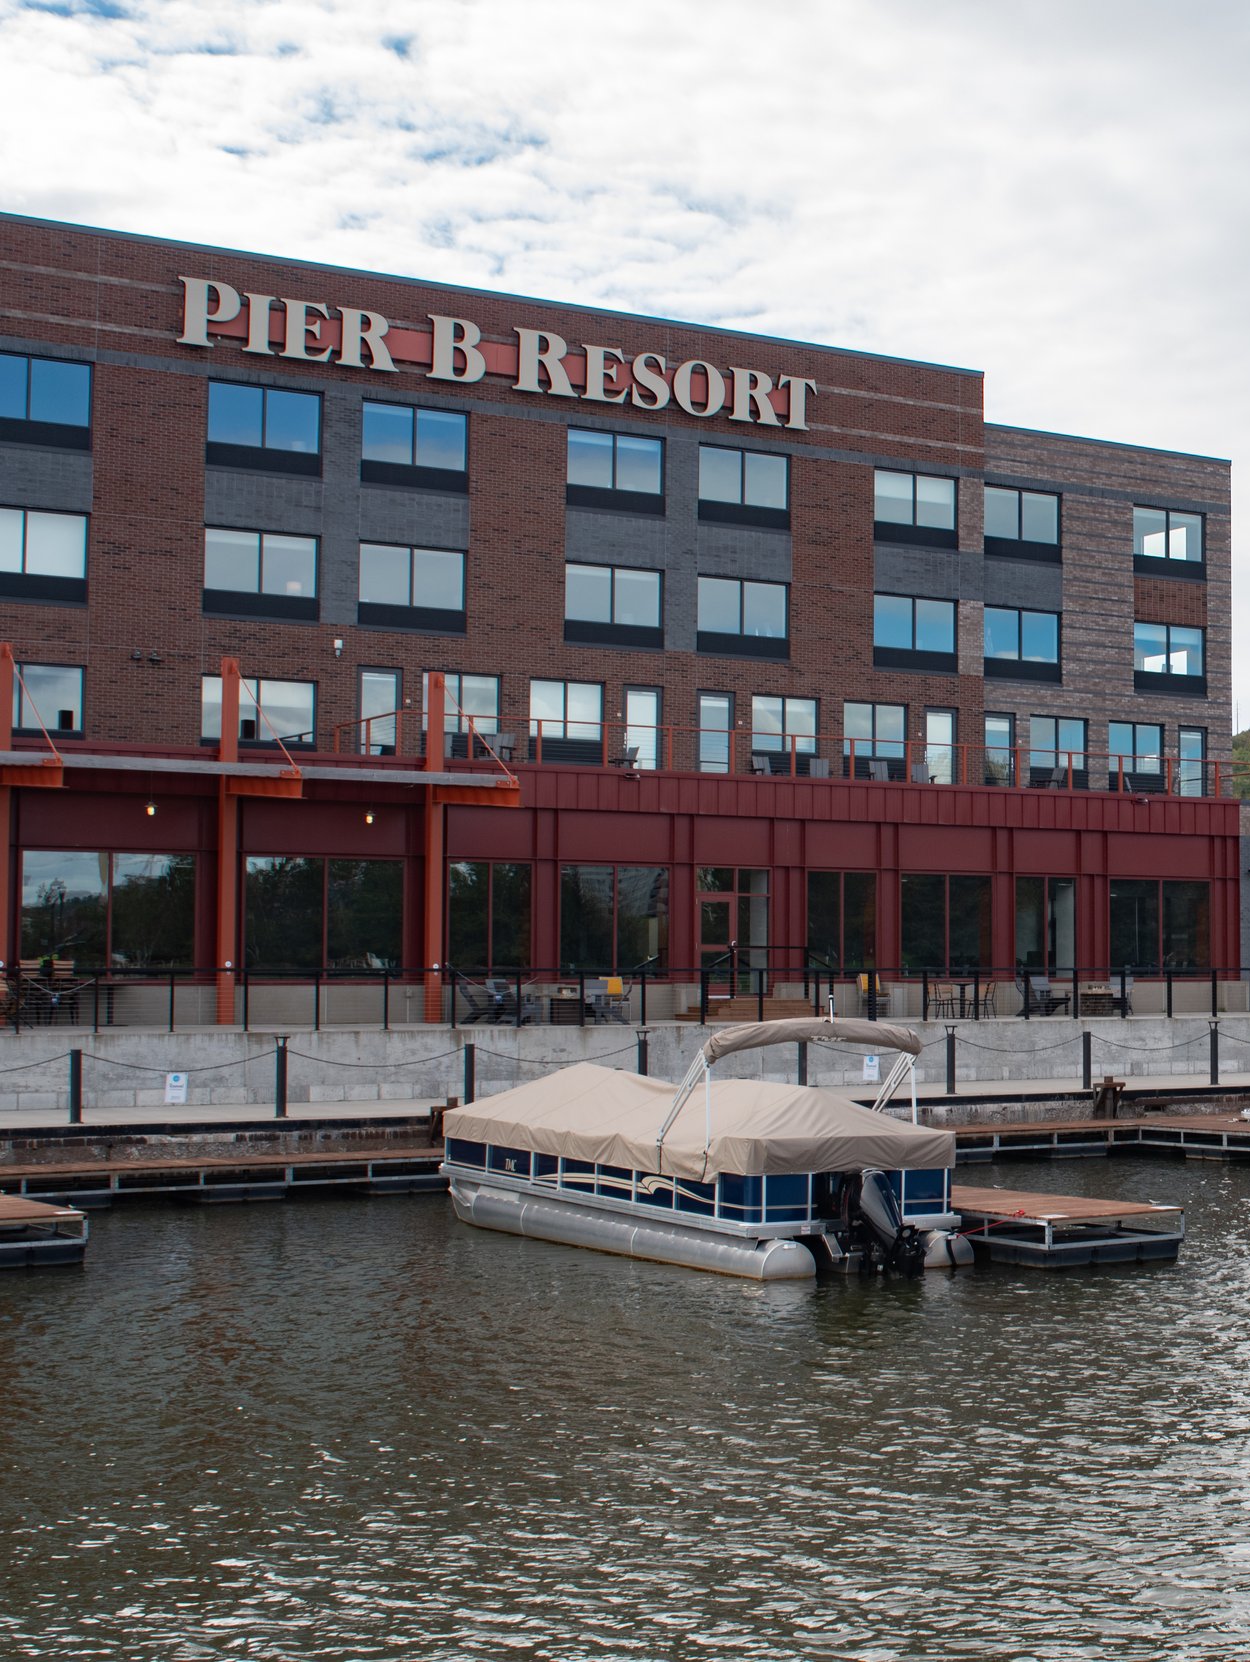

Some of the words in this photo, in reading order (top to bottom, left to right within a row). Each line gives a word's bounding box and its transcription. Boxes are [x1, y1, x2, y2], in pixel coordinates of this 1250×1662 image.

[176, 275, 399, 373] PIER
[427, 314, 486, 383] B
[513, 327, 818, 430] RESORT
